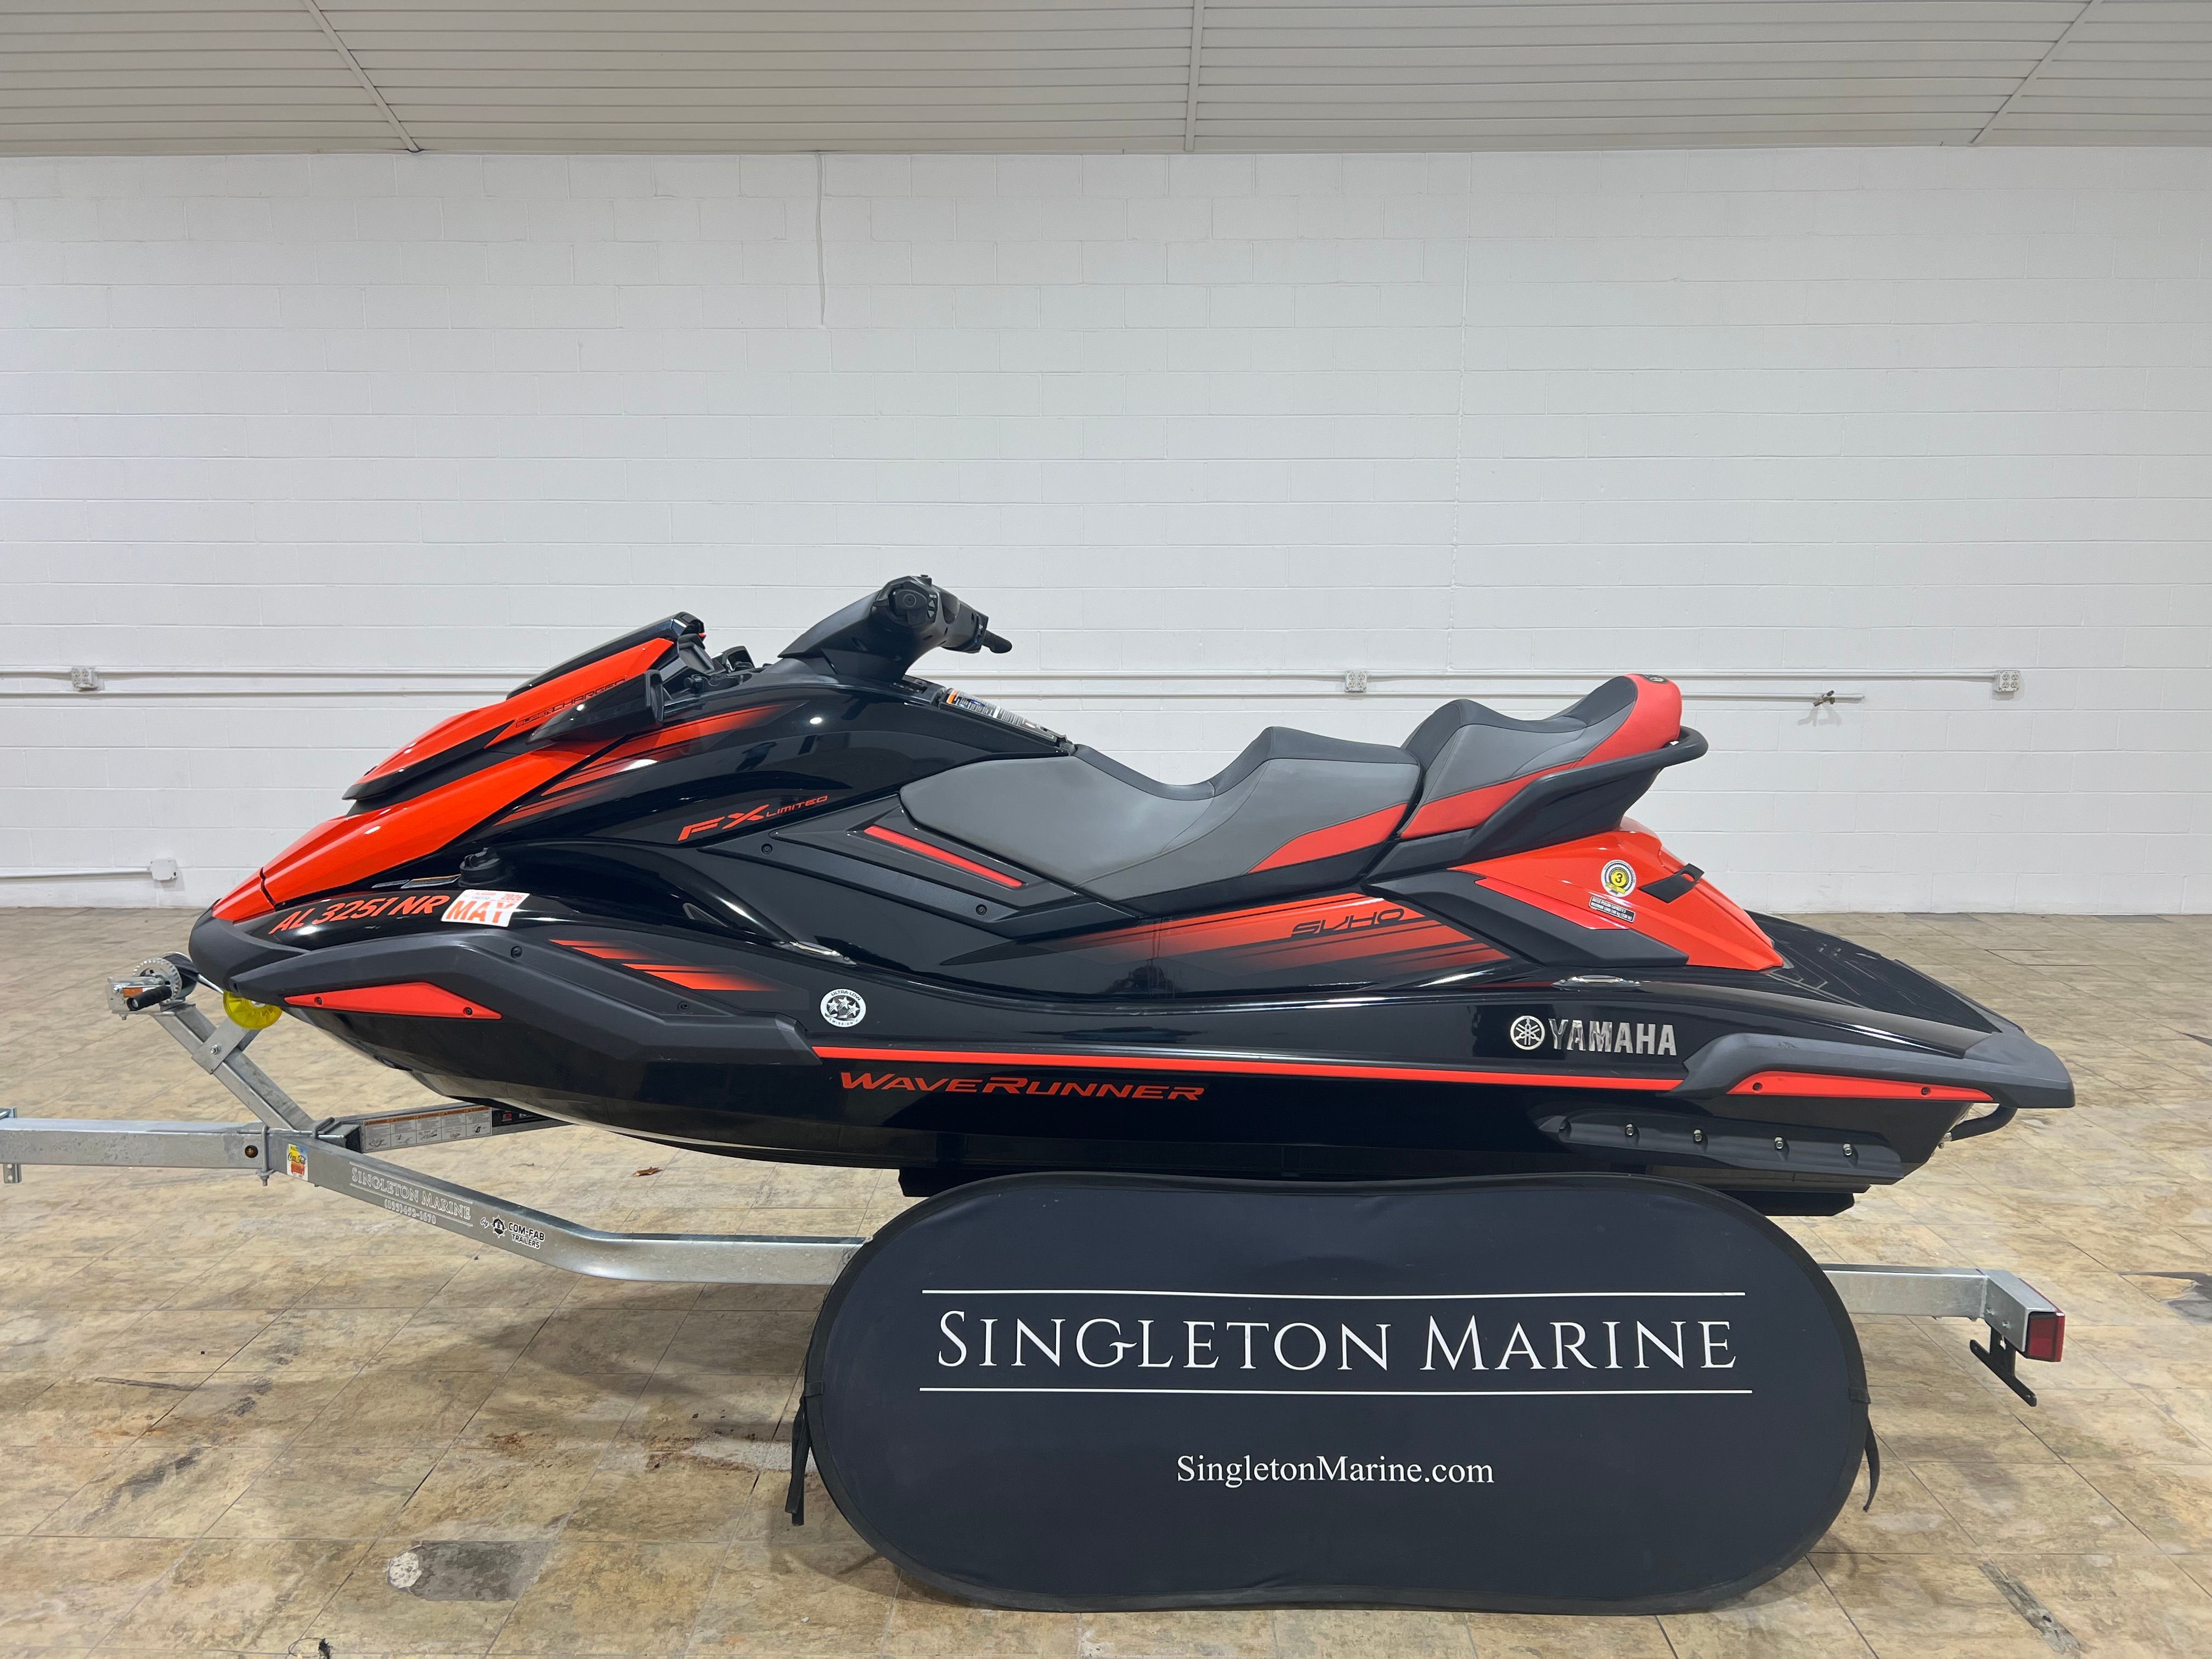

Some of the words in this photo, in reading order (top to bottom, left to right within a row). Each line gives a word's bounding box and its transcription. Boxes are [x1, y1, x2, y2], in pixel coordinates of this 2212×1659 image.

[678, 804, 769, 842] FX
[765, 795, 828, 817] LIMITED
[1615, 873, 1623, 883] 3
[269, 909, 315, 934] AL
[312, 898, 394, 925] 3251
[388, 895, 451, 916] NR
[445, 901, 516, 923] MAY
[831, 990, 861, 1001] ULTRA-LOW
[1548, 1018, 1677, 1056] YAMAHA
[840, 1071, 1205, 1101] WAVERUNNER
[352, 1167, 419, 1203] SINGLETON
[421, 1190, 471, 1221] MARINE
[509, 1222, 545, 1241] COM-FAB
[512, 1233, 540, 1249] TRAILERS
[939, 1311, 1391, 1370] SINGLETON
[1420, 1316, 1736, 1370] MARINE
[1178, 1455, 1494, 1488] SingletonMarine.com
